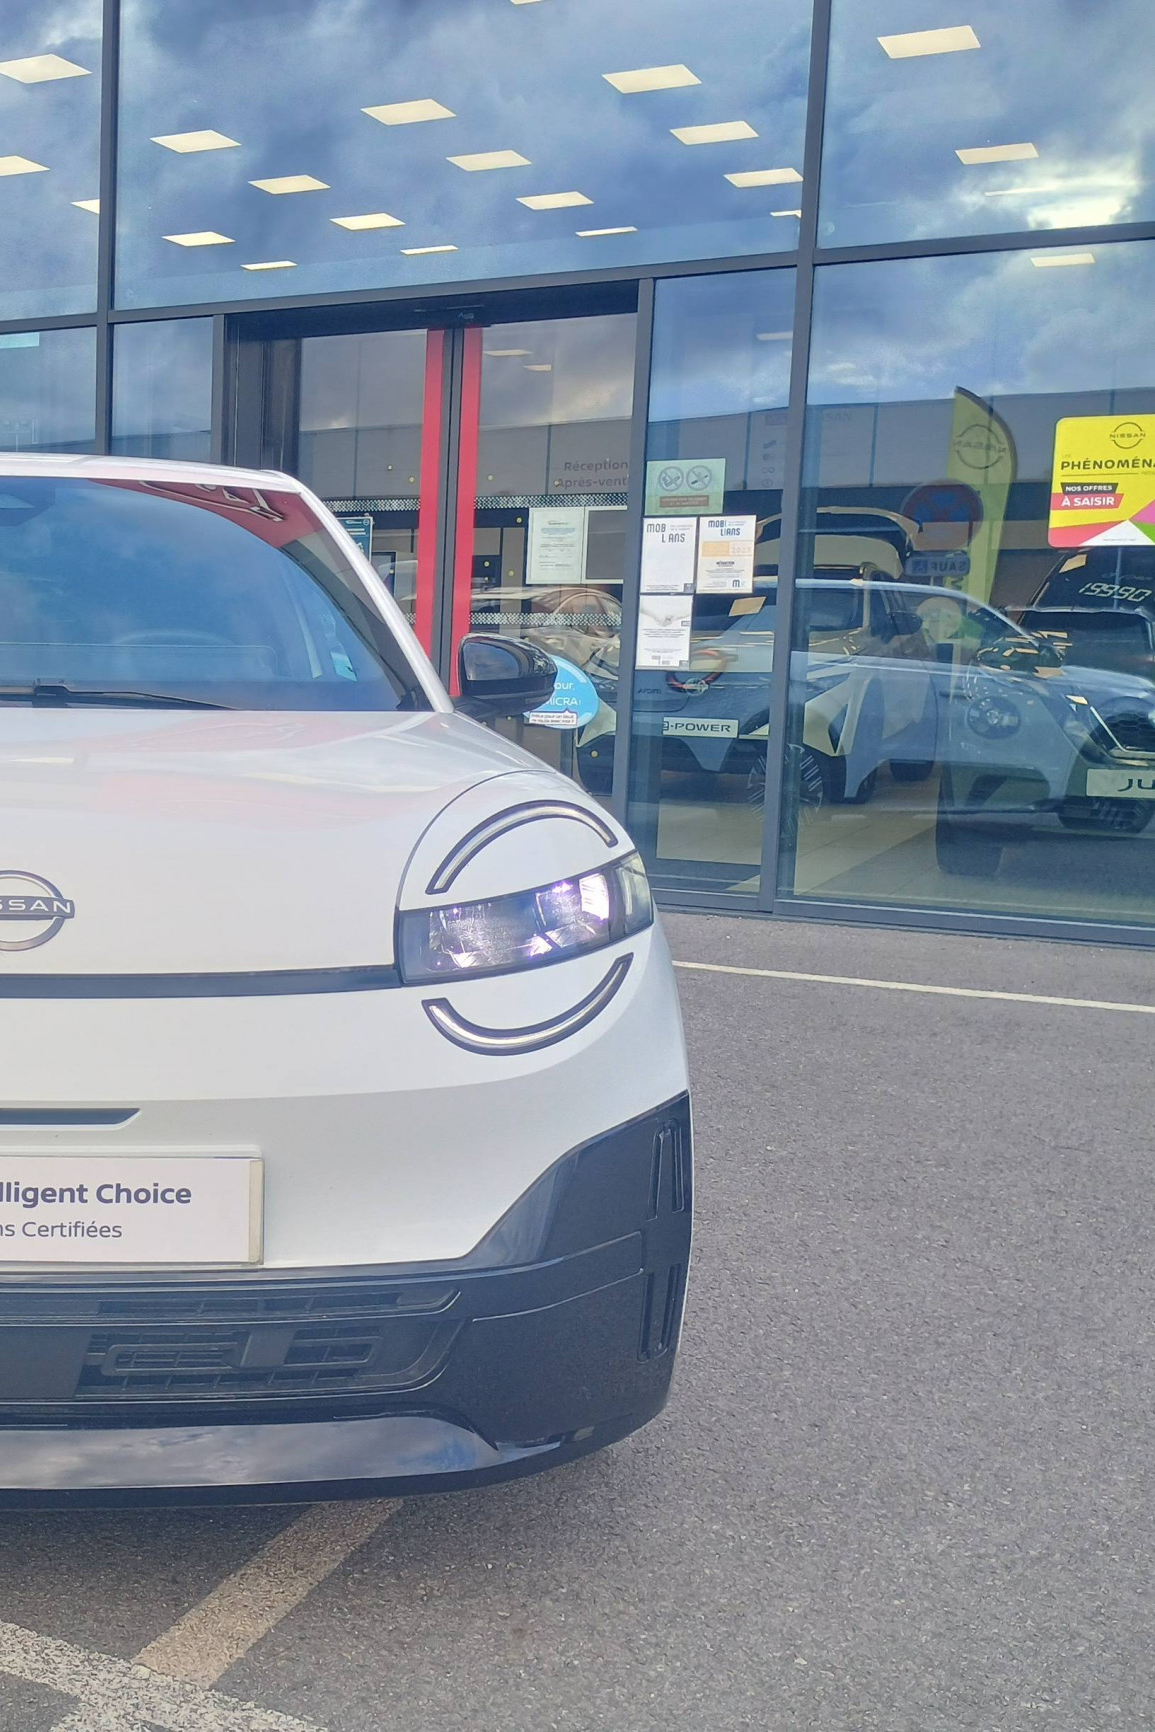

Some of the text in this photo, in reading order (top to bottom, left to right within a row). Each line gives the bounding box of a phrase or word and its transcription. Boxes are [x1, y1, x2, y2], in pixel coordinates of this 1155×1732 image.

[564, 460, 629, 472] Réception
[1060, 456, 1155, 471] PHÉNOMÉN
[556, 477, 629, 489] Après-vent
[1061, 495, 1115, 507] À SAISIR
[1078, 582, 1152, 602] 19990
[96, 1182, 192, 1204] Choice
[21, 1219, 123, 1239] Certifiées
